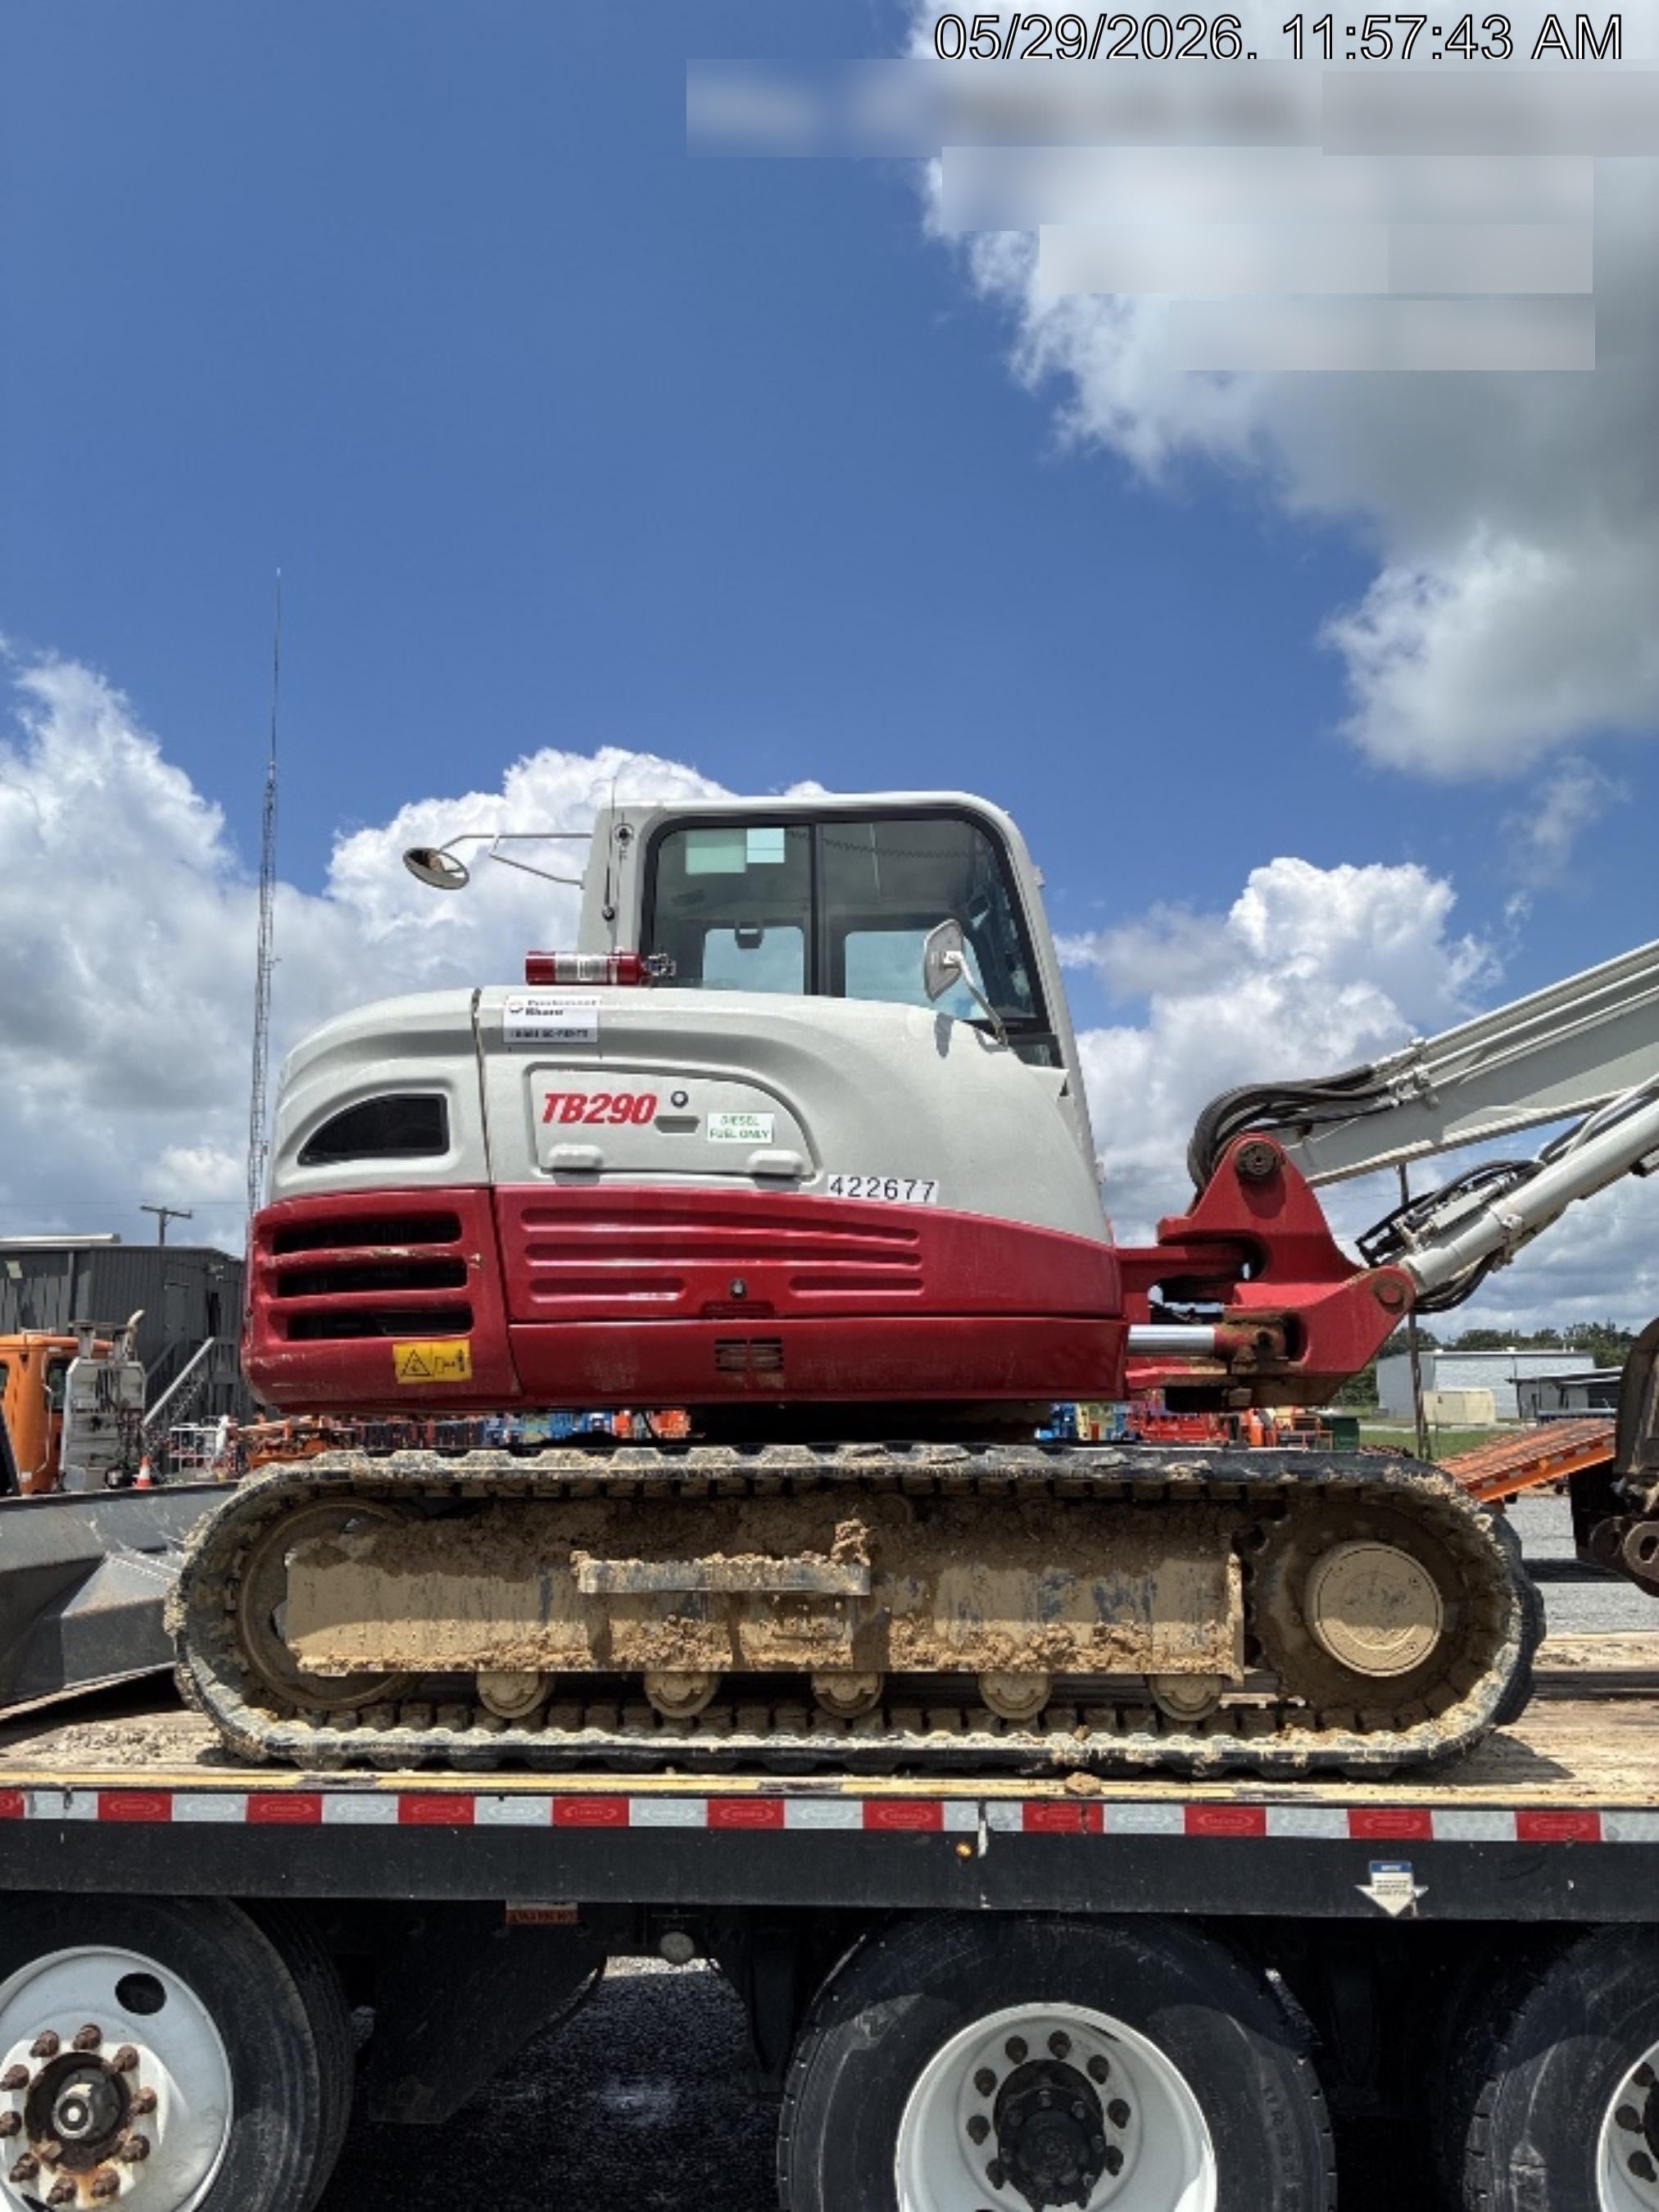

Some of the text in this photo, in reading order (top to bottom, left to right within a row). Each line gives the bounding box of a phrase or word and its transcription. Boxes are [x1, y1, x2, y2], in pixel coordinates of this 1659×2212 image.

[542, 1093, 657, 1124] TB290
[710, 1127, 770, 1140] FUEL ONLY
[830, 1176, 936, 1202] 422677
